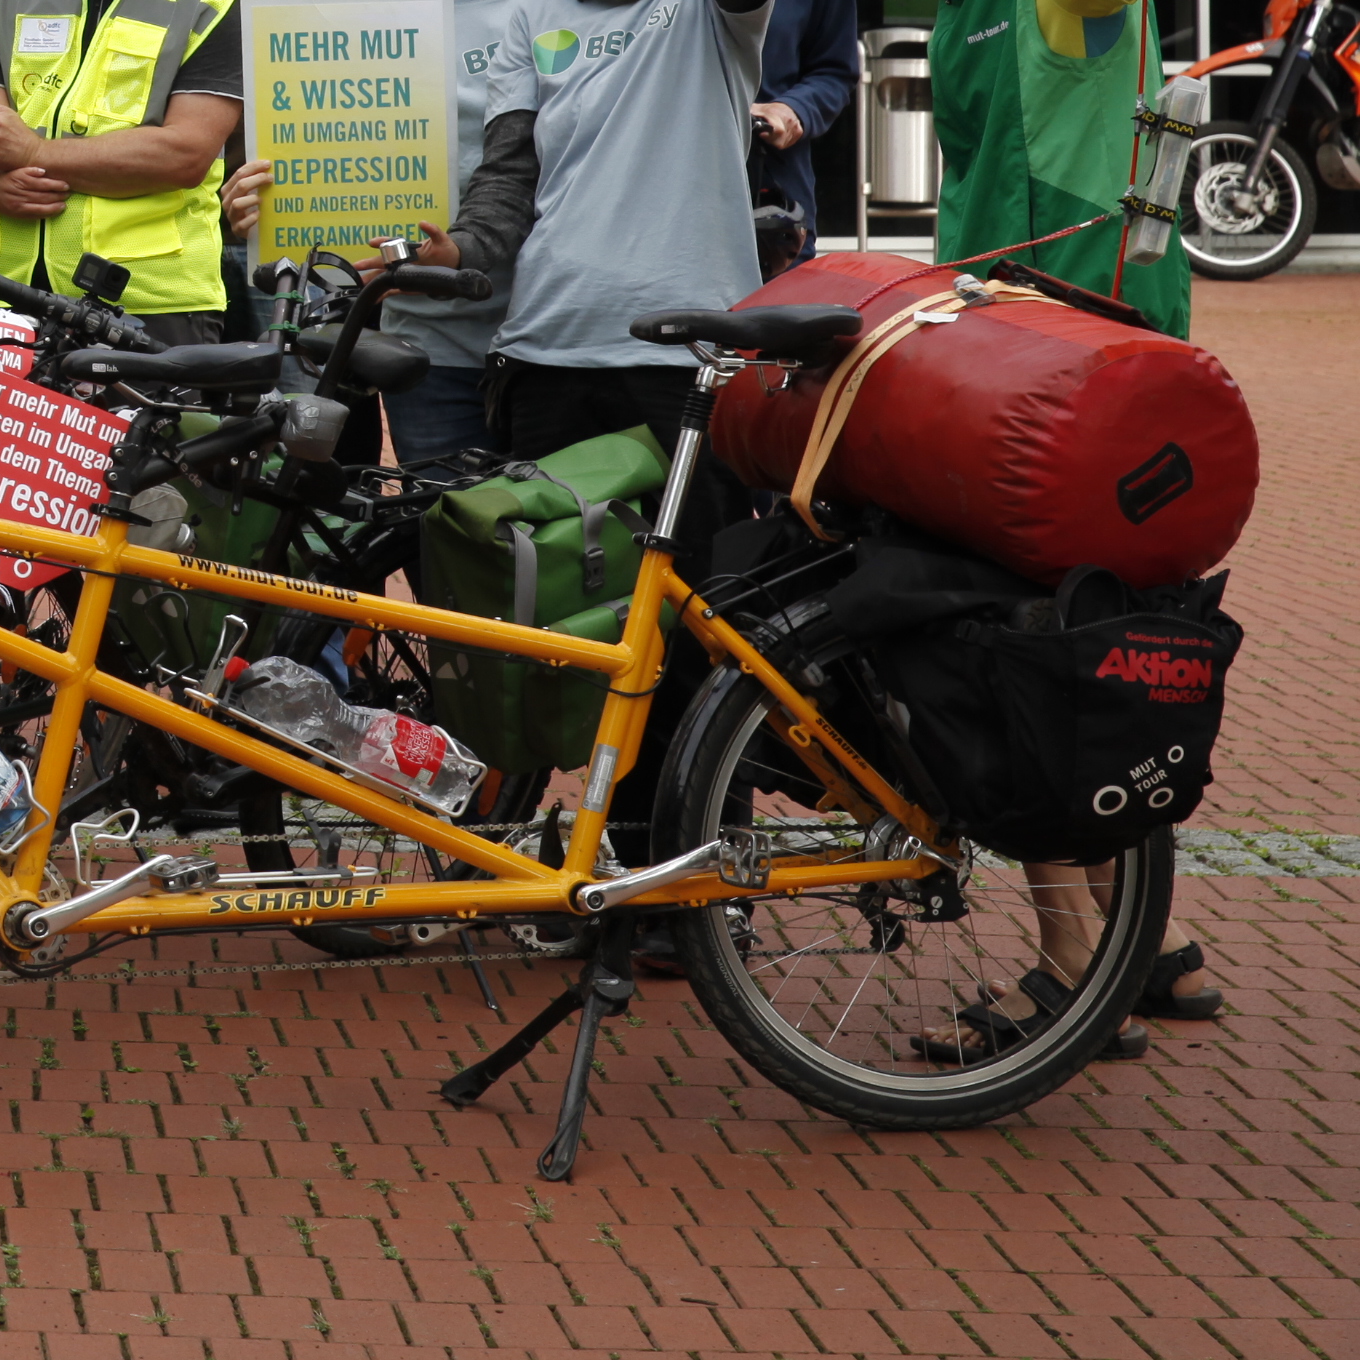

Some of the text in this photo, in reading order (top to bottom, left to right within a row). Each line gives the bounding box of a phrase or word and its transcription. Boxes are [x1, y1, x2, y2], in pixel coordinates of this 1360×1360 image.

[269, 28, 419, 63] MEHR MUT
[967, 20, 1009, 45] mut-tour.de
[272, 77, 411, 111] & WISSEN
[272, 118, 429, 144] IM UMGANG MIT
[273, 155, 428, 185] DEPRESSION
[274, 193, 438, 213] UND ANDEREN PSYCH.
[8, 387, 59, 419] mehr
[60, 403, 97, 434] Mut
[29, 422, 52, 448] im
[56, 432, 114, 472] Umgan
[0, 442, 42, 474] dem
[45, 458, 102, 500] Thema
[177, 553, 360, 604] www.mut-tour.de
[1125, 631, 1171, 646] Gefördert
[1173, 636, 1200, 648] durch
[1148, 688, 1209, 704] MENSCH
[1129, 757, 1158, 782] MUT
[1134, 768, 1168, 794] TOUR
[208, 886, 386, 916] SCHAUFF
